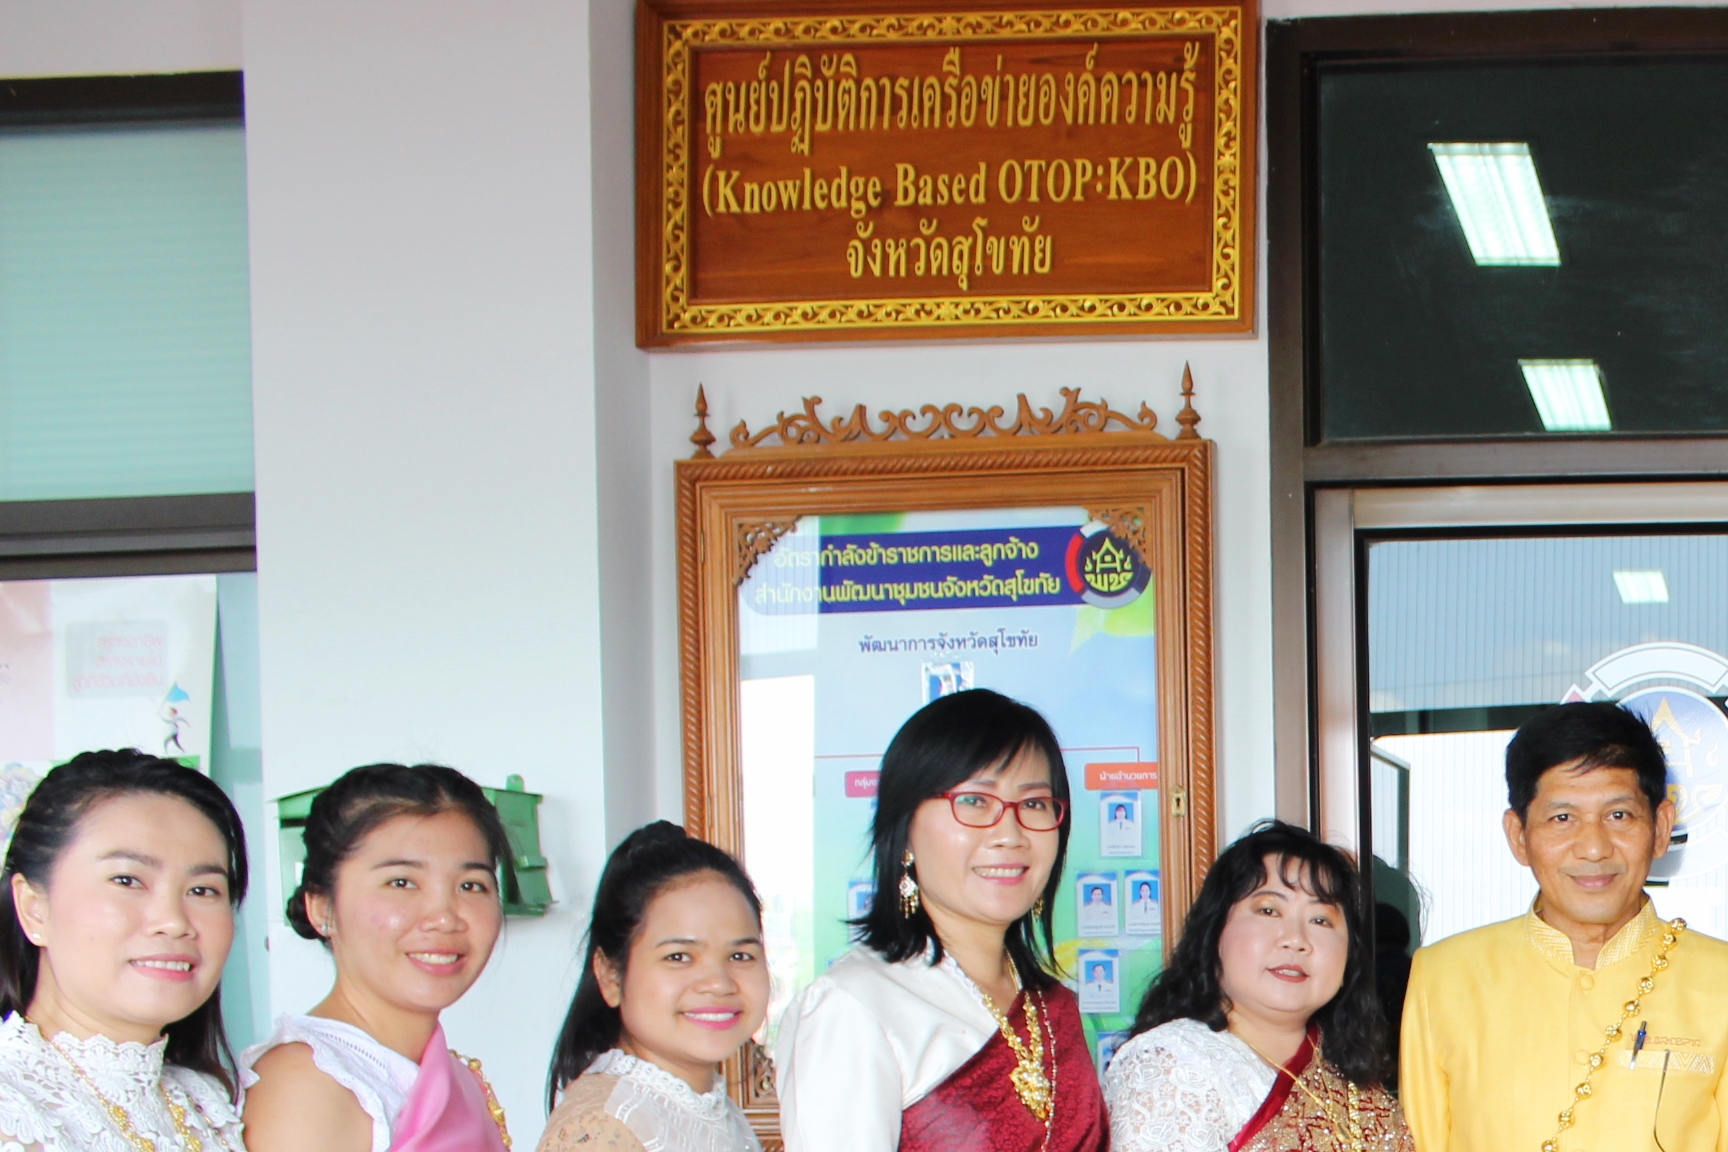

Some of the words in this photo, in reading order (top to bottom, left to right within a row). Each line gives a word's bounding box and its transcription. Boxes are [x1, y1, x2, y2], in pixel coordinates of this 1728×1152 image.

[703, 42, 1200, 158] ศูนย์ปฏิบัติการเครือข่ายองค์ความรู้
[702, 166, 882, 217] (Knowledge
[895, 162, 986, 206] Based
[998, 151, 1197, 204] OTOP:KBO)
[845, 215, 1053, 290] จังหวัดสุโขทัย
[858, 628, 1039, 657] พัฒนาการจังหวัดสุโขทัย
